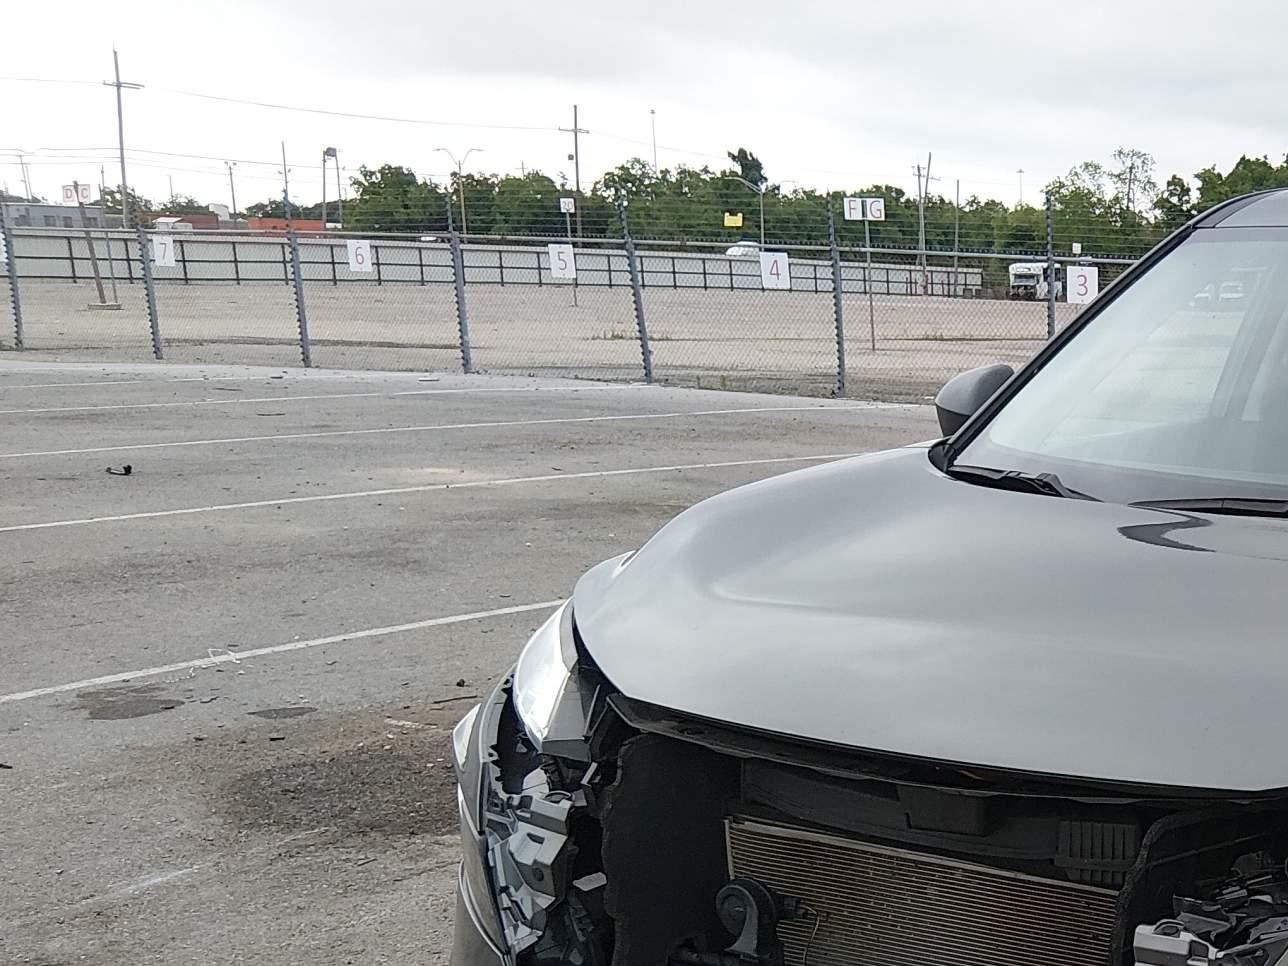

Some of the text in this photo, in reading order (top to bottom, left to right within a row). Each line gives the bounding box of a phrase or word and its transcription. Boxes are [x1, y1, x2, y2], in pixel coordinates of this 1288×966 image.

[65, 187, 89, 199] D C
[849, 199, 882, 219] F G
[159, 242, 168, 260] 7
[355, 246, 365, 265] 6
[557, 251, 568, 271] 5
[769, 259, 782, 281] 4
[1076, 274, 1089, 297] 3
